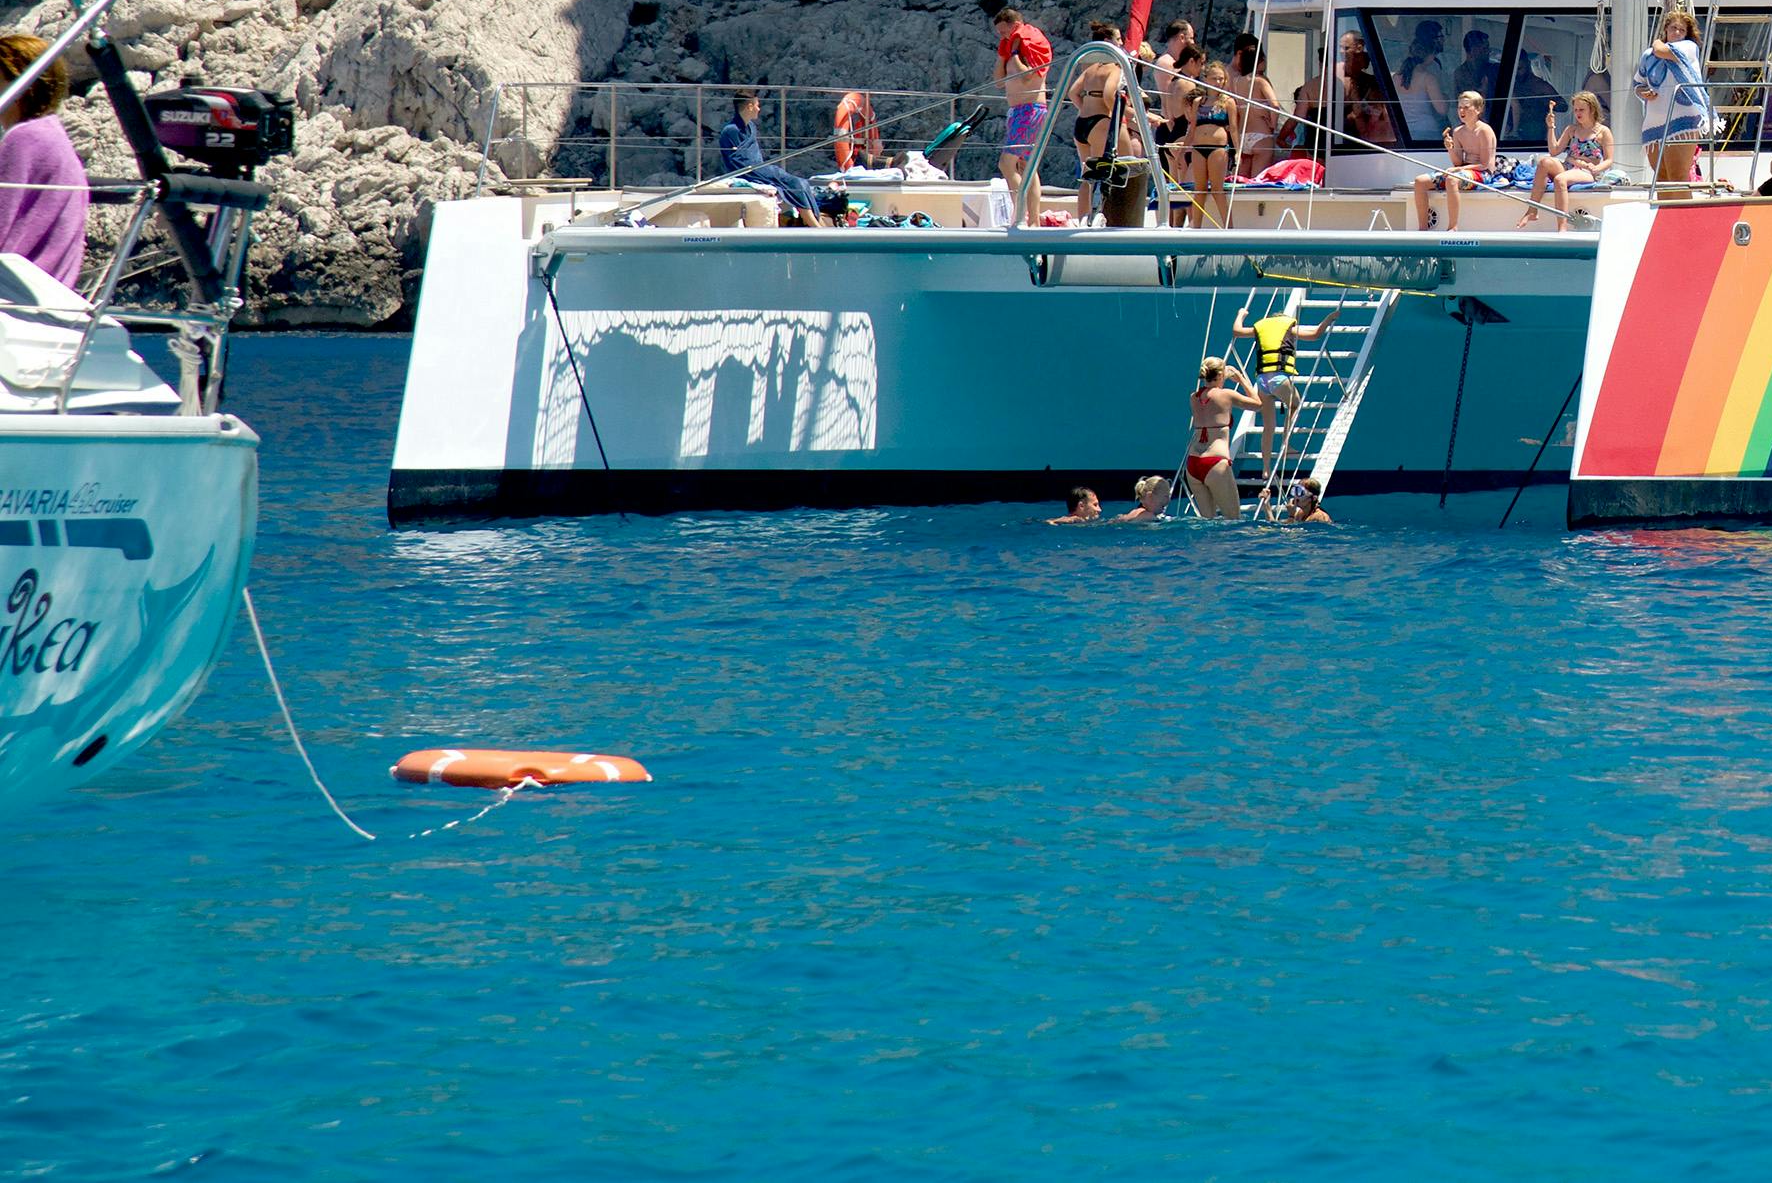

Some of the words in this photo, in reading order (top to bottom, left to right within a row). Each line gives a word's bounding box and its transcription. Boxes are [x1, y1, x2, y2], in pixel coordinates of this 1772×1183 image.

[159, 110, 211, 125] SUZUKI
[205, 132, 236, 148] 22
[0, 489, 69, 515] AVARIA
[94, 493, 139, 514] cruiser
